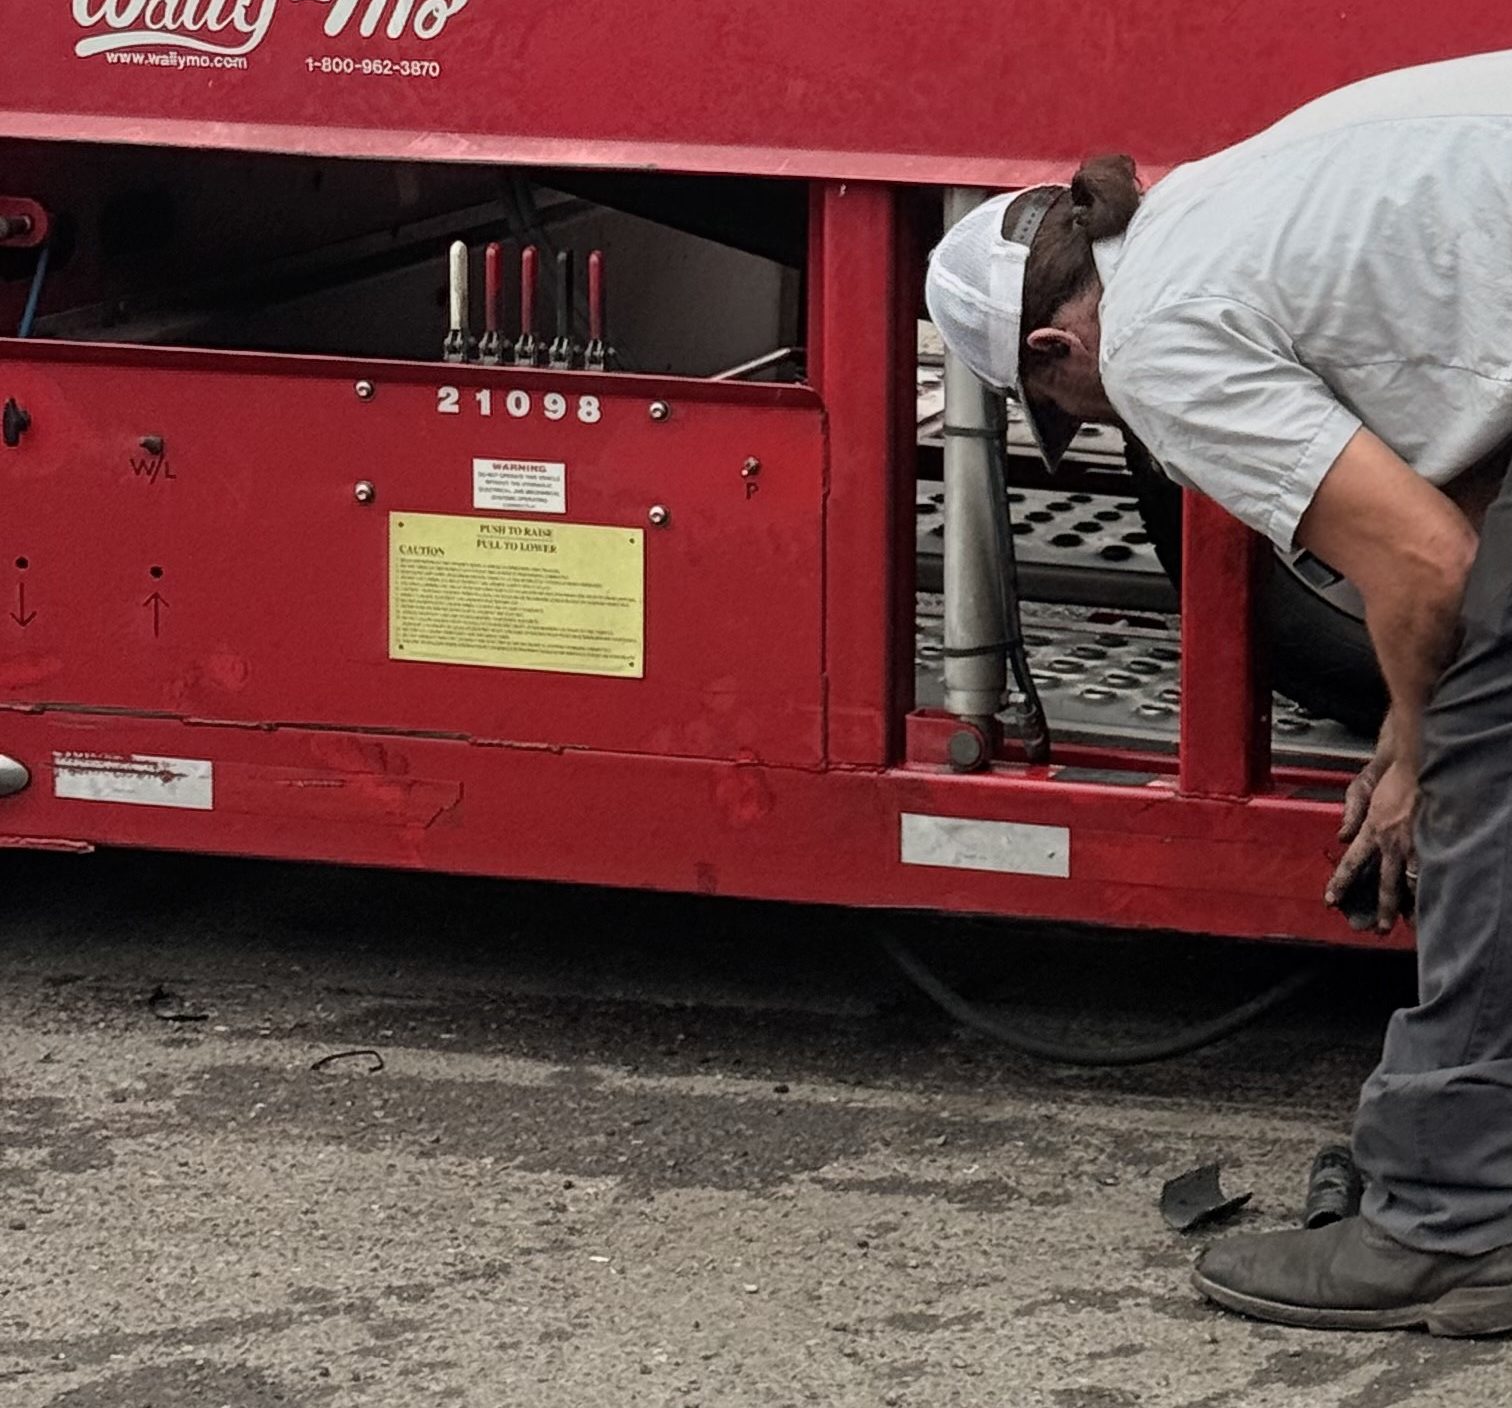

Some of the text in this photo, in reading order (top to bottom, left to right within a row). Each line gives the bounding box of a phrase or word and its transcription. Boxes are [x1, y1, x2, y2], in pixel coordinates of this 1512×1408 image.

[106, 51, 248, 70] www.wallymo.com
[305, 56, 441, 77] 1-800-962-3870
[437, 386, 602, 423] 21098
[492, 463, 547, 473] WARNING
[480, 524, 552, 537] PUSH TO RAISE
[399, 544, 445, 556] CAUTION
[477, 539, 558, 553] PULL TO LOWER
